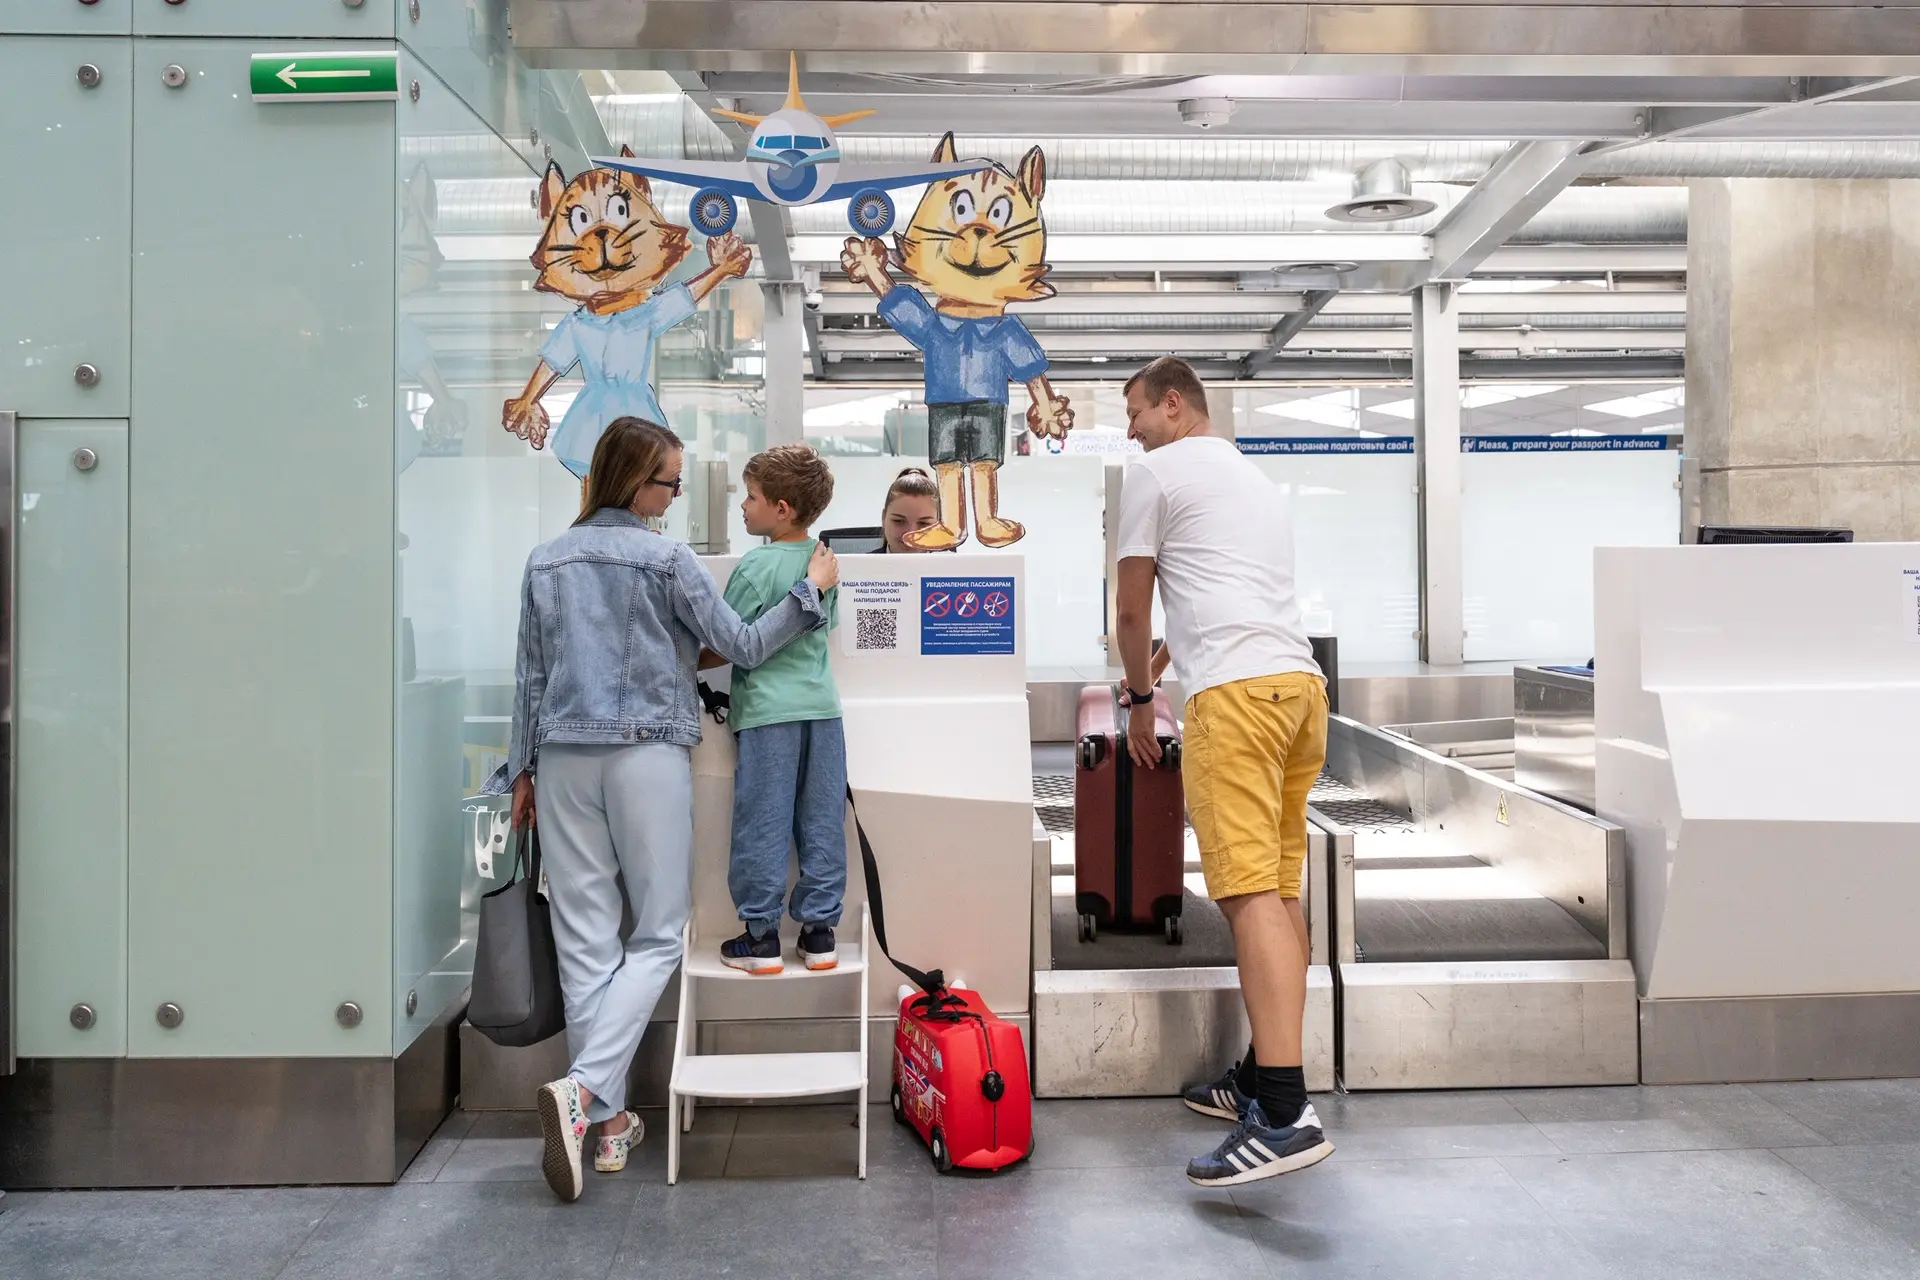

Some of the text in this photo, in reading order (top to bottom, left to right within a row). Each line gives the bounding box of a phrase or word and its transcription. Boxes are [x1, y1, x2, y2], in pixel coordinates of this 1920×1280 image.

[1236, 441, 1291, 453] Пожалуйста,
[1292, 442, 1329, 452] заранее
[1330, 442, 1385, 452] подготовьте
[1386, 441, 1408, 450] свой
[1478, 439, 1660, 451] Please, prepare your passport in advance
